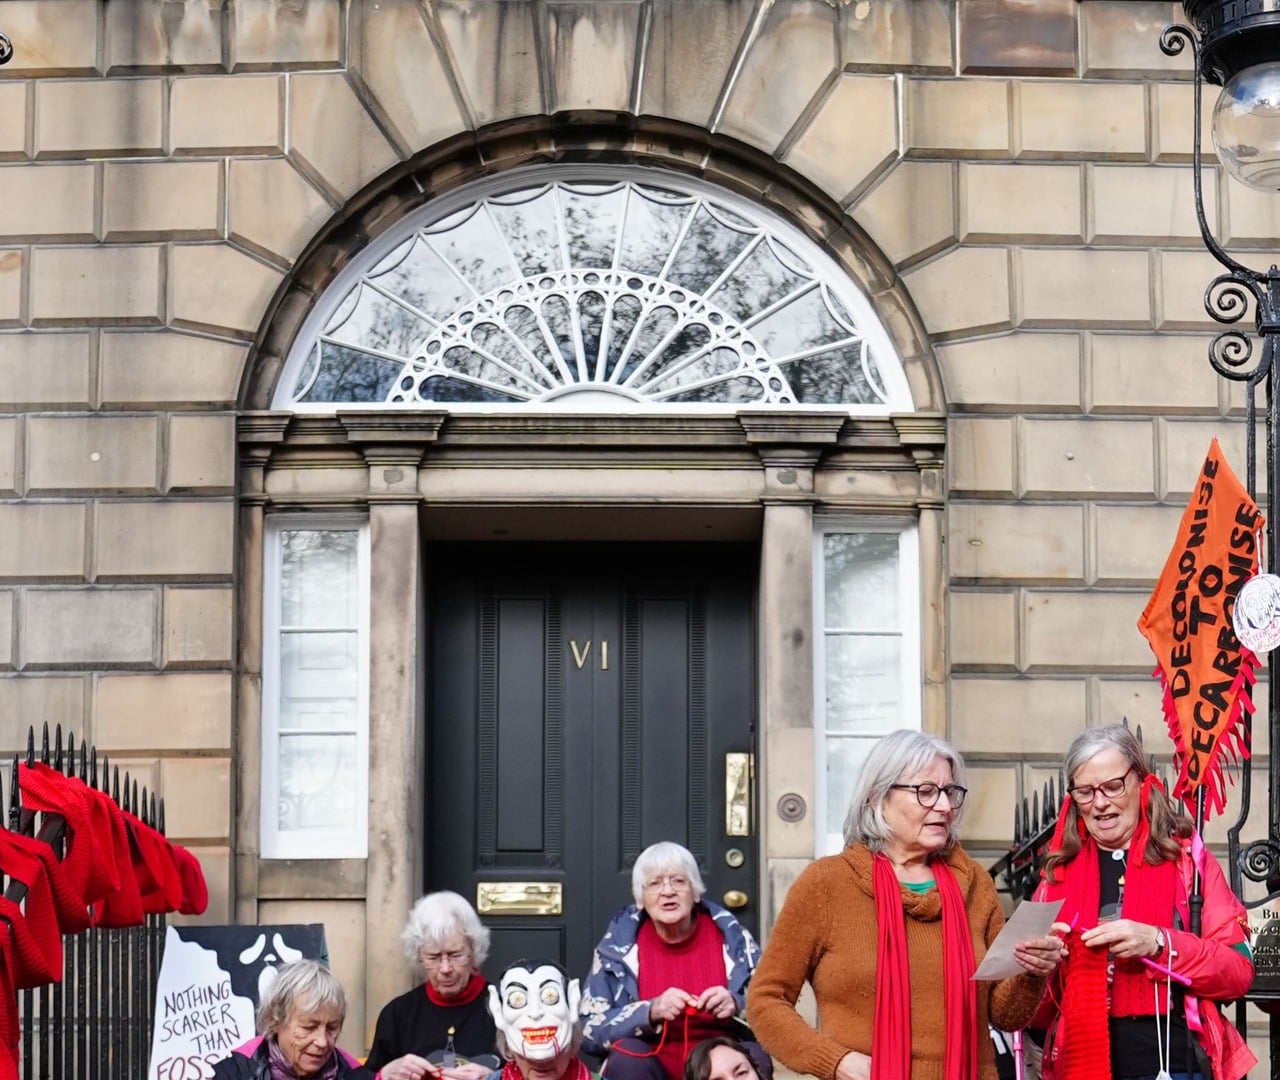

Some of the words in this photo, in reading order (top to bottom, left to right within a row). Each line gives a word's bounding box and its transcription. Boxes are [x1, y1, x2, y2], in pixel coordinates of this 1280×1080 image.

[1170, 456, 1219, 699] DECOLONISE
[1189, 564, 1224, 635] TO
[569, 640, 608, 671] VI
[1187, 502, 1261, 781] DECARBONISE
[164, 980, 231, 1018] NOTHING
[160, 1003, 236, 1043] SCARIER
[190, 1024, 241, 1055] THAN
